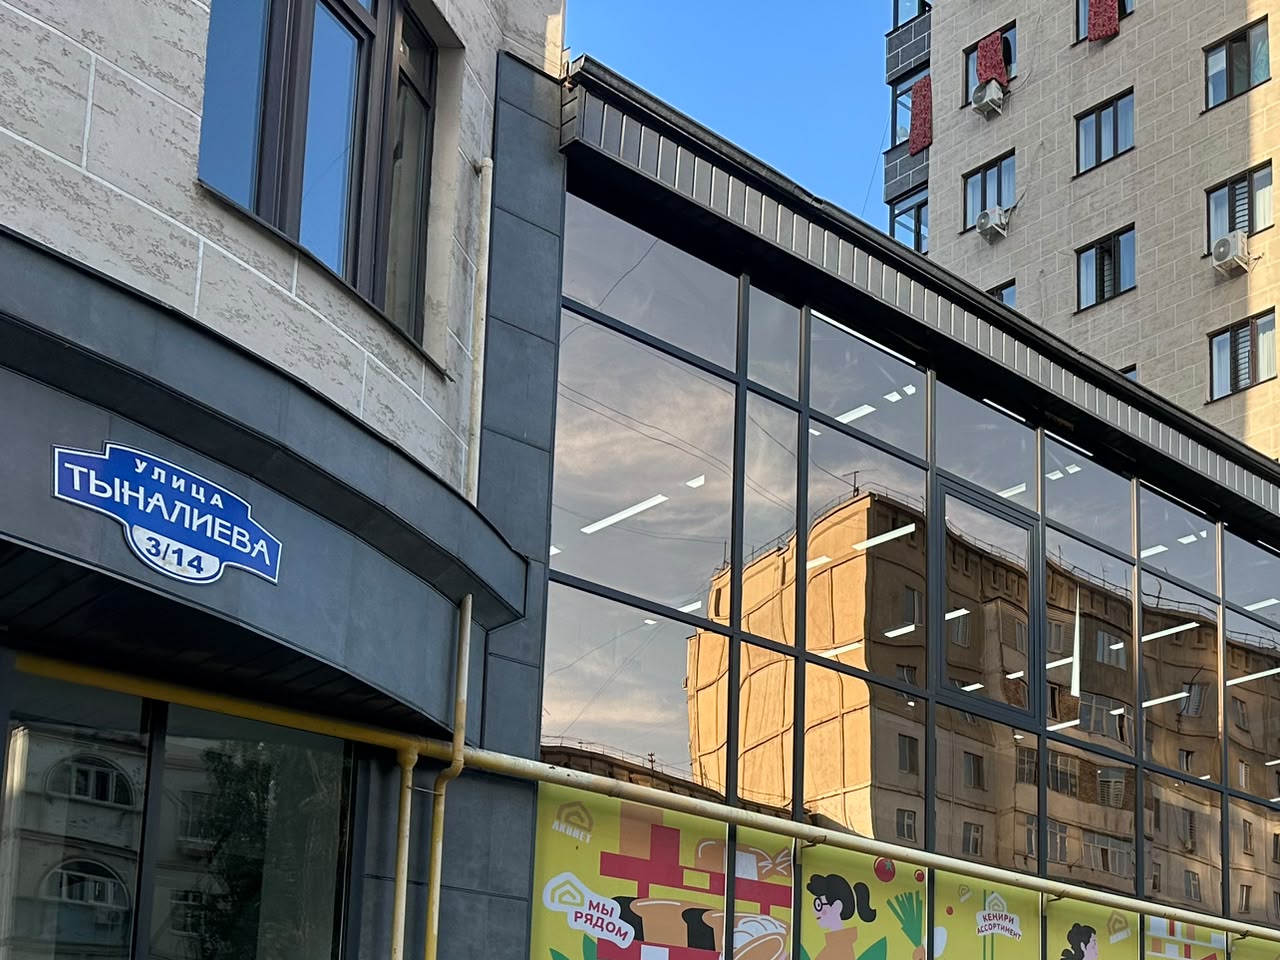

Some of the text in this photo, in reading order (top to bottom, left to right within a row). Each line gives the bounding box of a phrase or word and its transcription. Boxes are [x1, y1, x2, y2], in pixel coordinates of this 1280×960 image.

[134, 458, 224, 509] УЛИЦА
[64, 462, 271, 566] ТЫНАЛИЕВА
[146, 536, 204, 574] 3/14
[574, 910, 629, 941] РЯДОМ
[588, 899, 614, 918] МЫ
[977, 923, 1022, 940] АССОРТИМЕНТ
